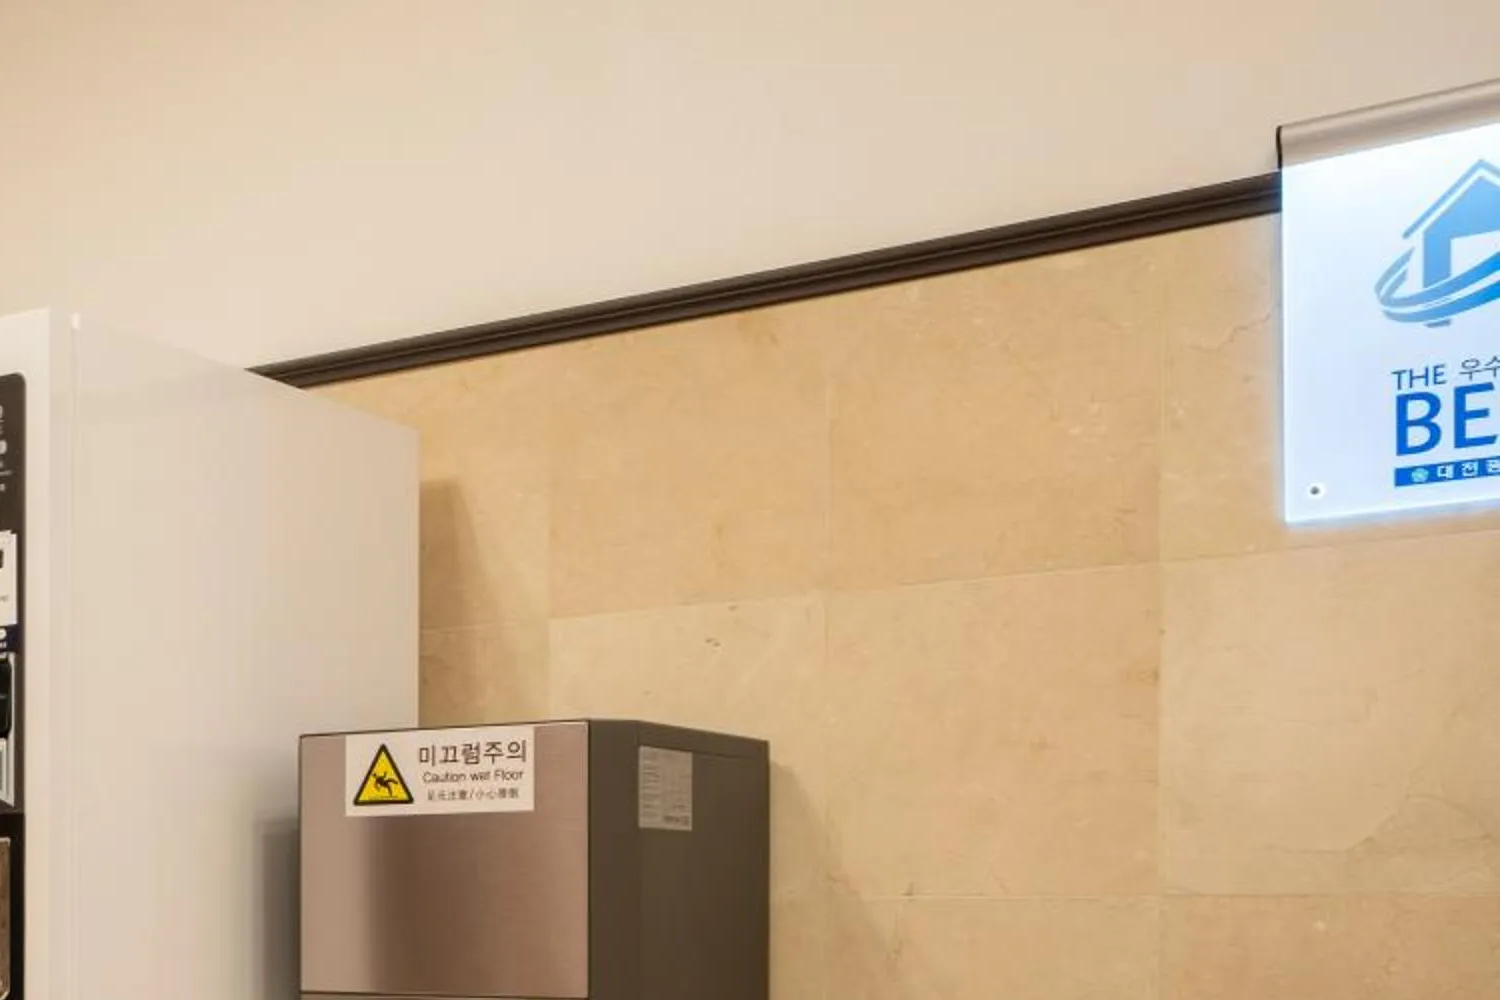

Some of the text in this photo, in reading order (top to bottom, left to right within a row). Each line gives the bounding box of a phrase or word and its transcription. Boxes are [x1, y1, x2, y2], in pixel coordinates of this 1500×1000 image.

[1391, 355, 1500, 390] THE 우수
[1395, 382, 1498, 456] BE
[419, 740, 526, 767] 미끄럼주의
[423, 768, 524, 783] Caution wet Floor
